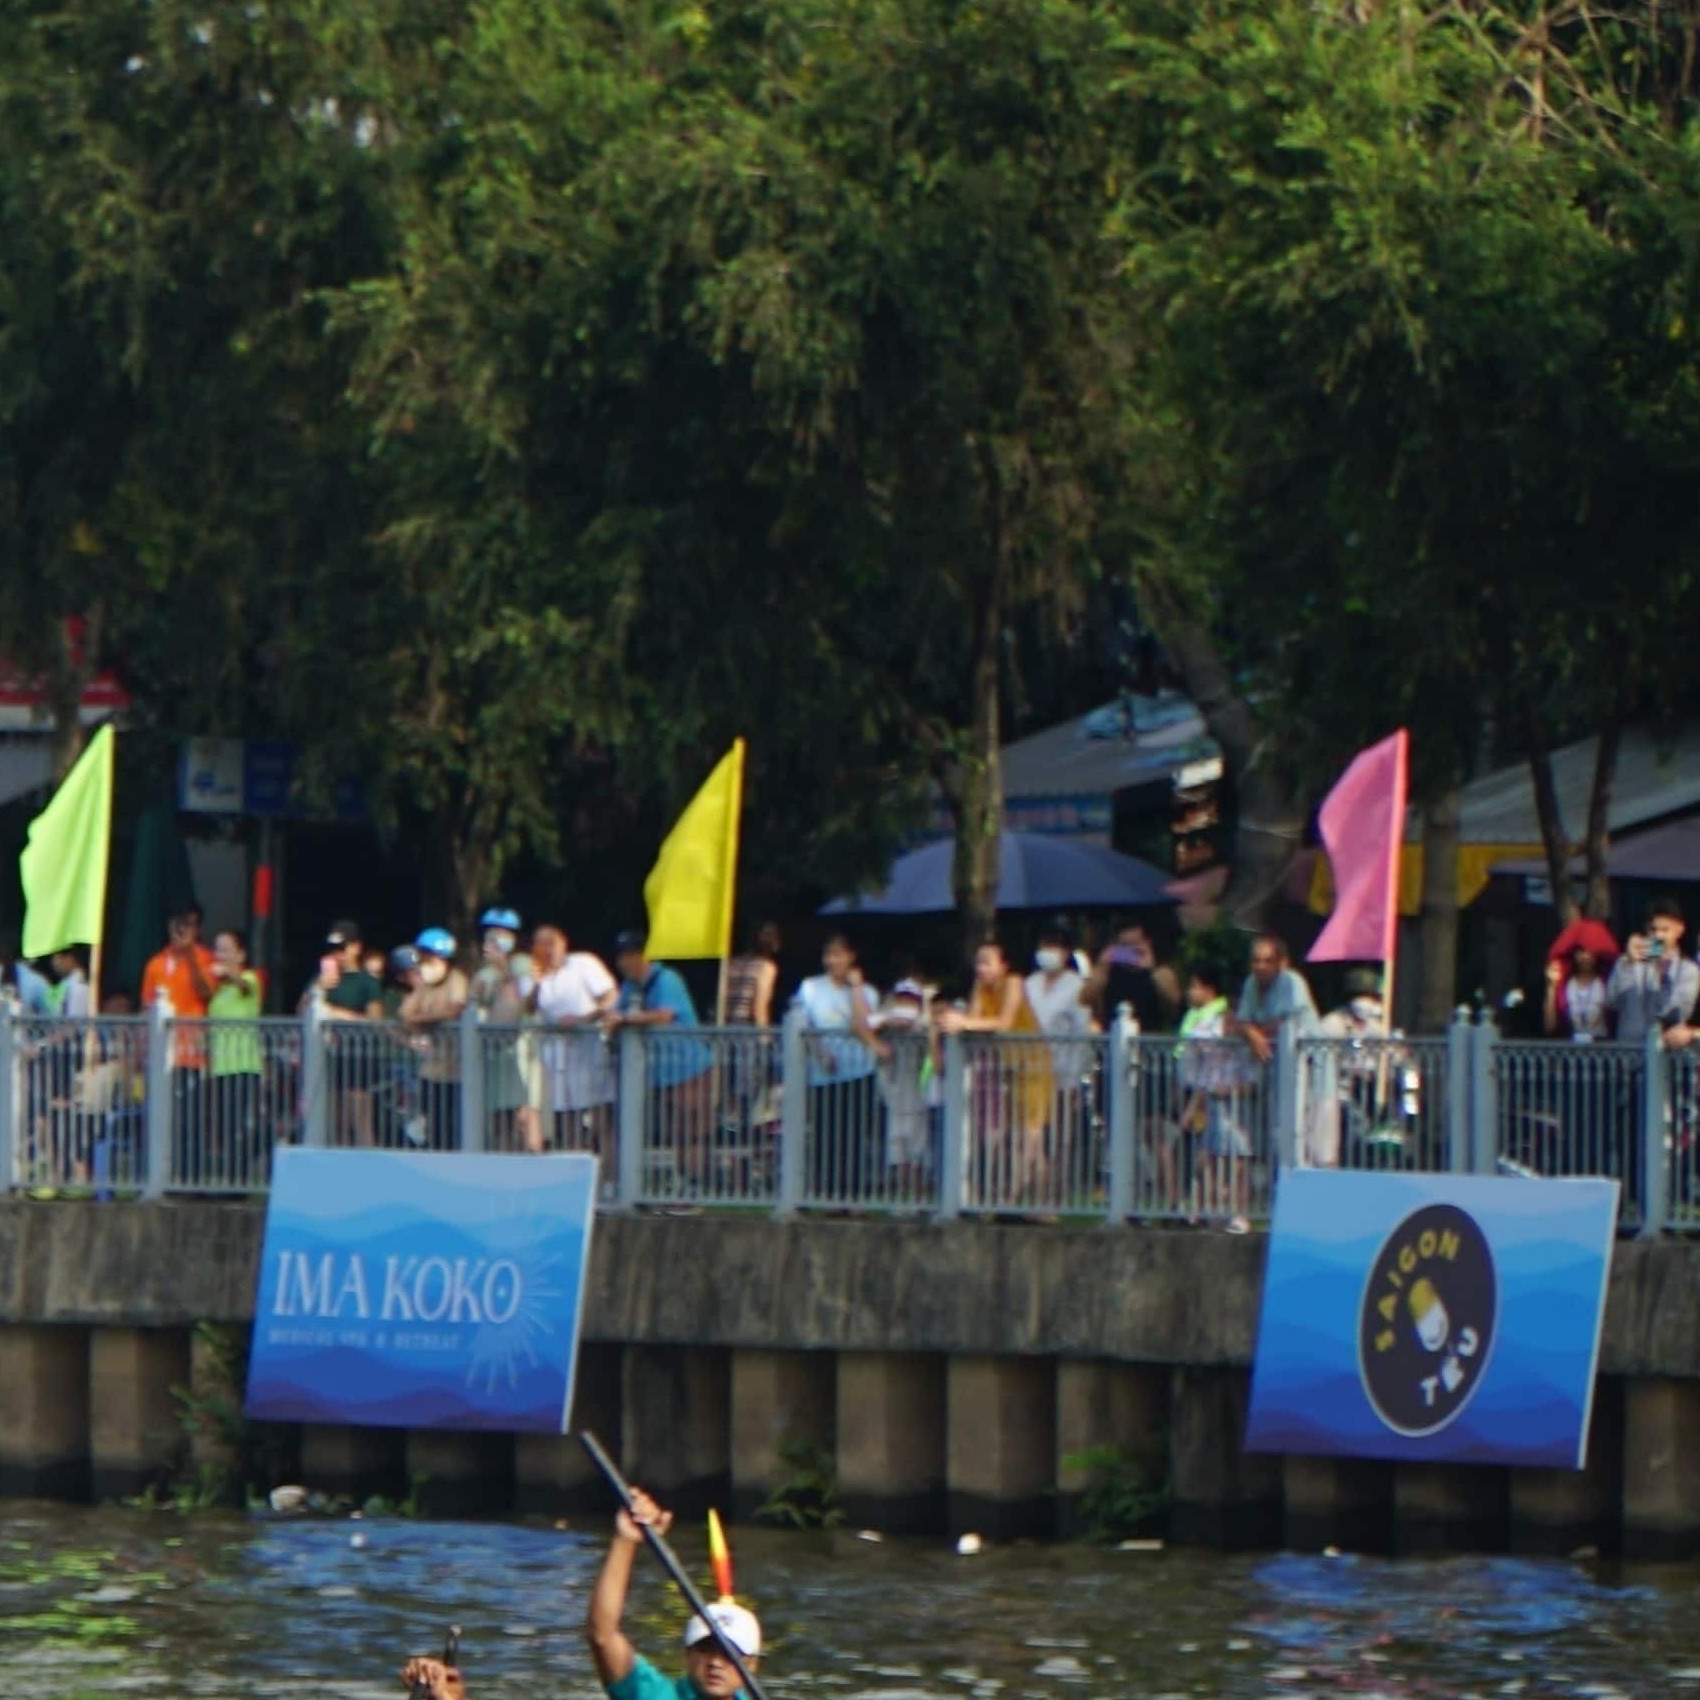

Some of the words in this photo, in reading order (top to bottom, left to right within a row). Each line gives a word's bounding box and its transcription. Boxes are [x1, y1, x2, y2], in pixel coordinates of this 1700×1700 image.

[272, 1251, 370, 1319] IMA
[379, 1255, 522, 1324] KOKO
[1374, 1228, 1461, 1353] SAIGON
